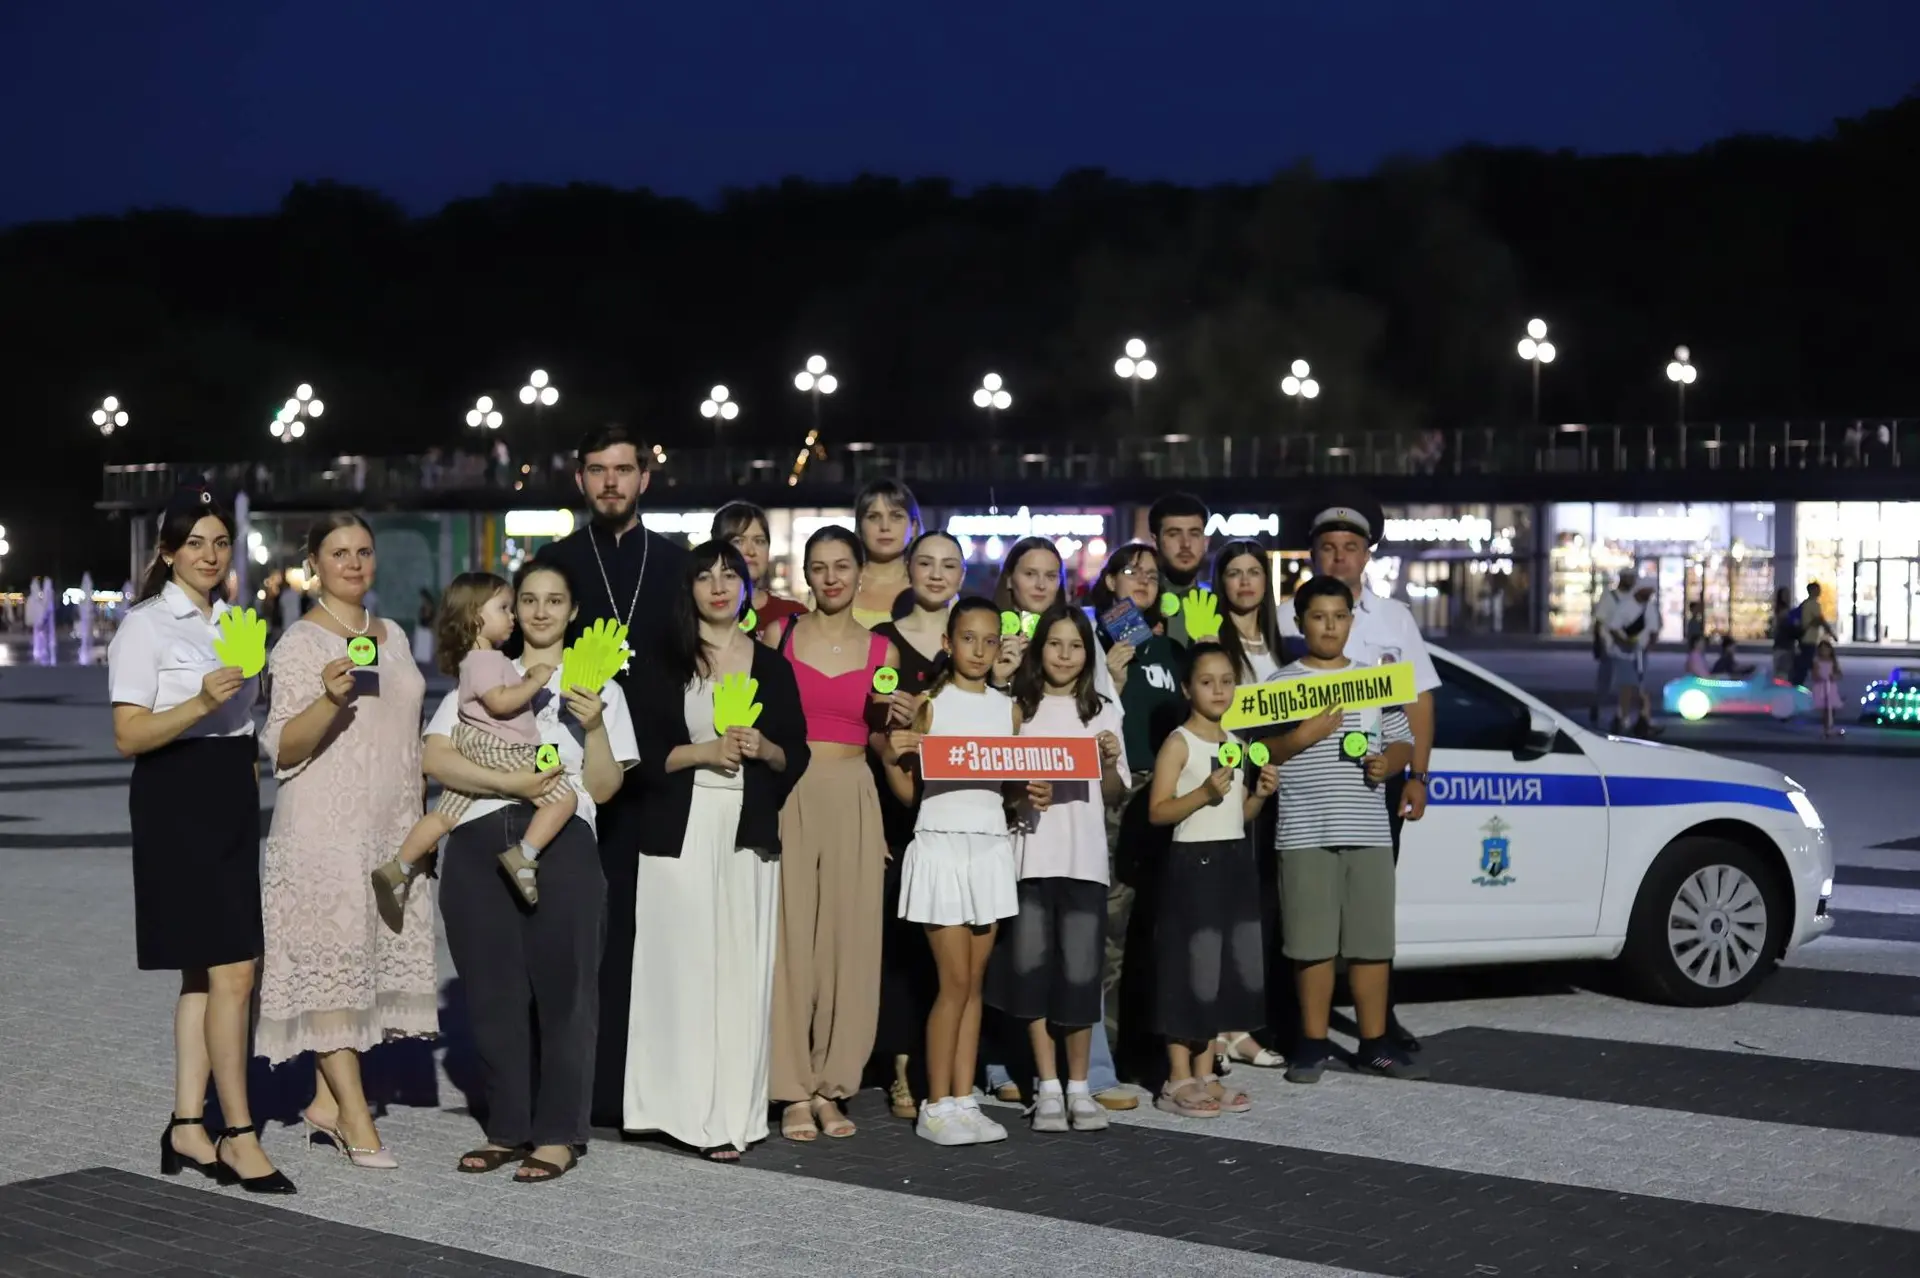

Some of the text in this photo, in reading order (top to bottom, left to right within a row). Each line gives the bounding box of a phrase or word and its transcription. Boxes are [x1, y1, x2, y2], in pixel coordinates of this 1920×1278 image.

[1239, 675, 1393, 721] #БудьЗаметным
[948, 741, 1075, 771] #Засветись
[1429, 784, 1543, 806] ОЛИЦИЯ
